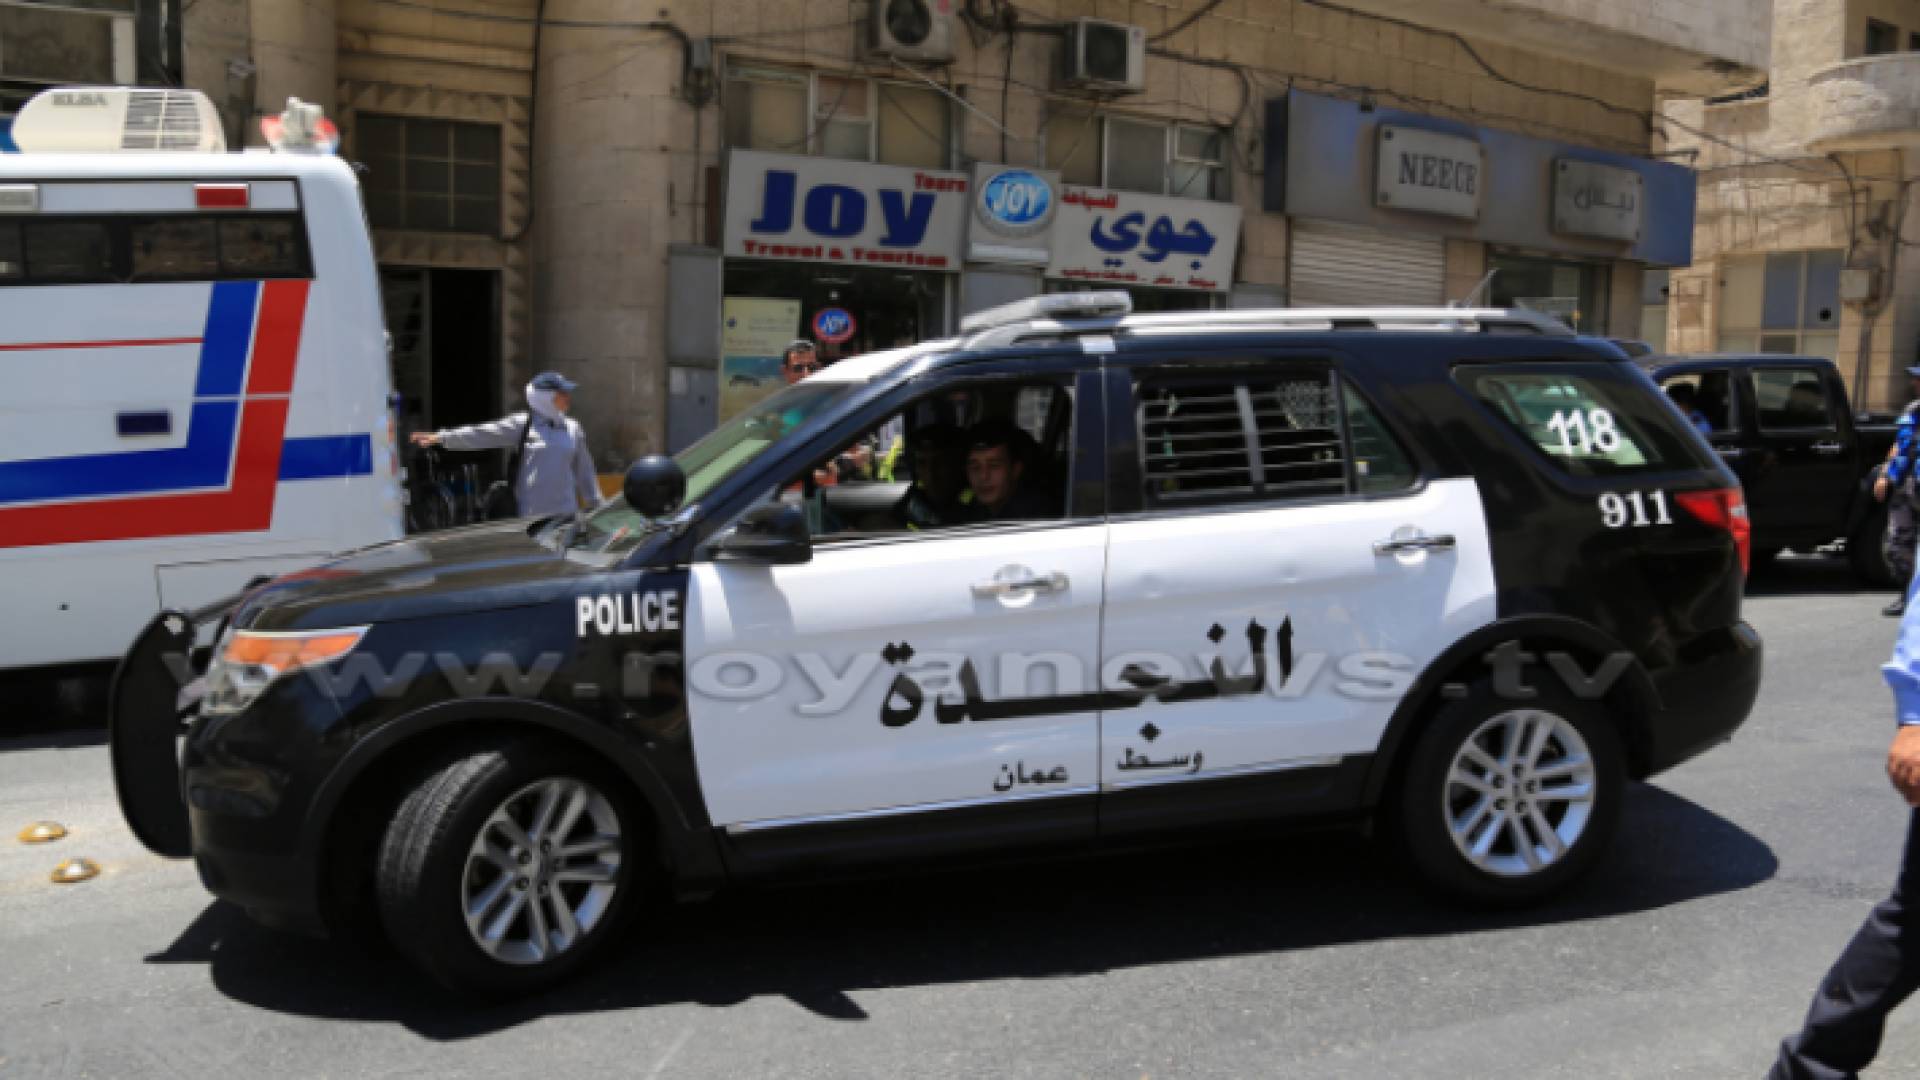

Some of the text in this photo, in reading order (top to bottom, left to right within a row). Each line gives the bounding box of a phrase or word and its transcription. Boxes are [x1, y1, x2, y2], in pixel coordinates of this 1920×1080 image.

[1398, 151, 1478, 197] NEECE
[992, 181, 1042, 216] JOY
[742, 239, 824, 258] Travel
[1089, 209, 1217, 271] جوي
[1547, 407, 1621, 457] 118
[1598, 488, 1673, 528] 911
[576, 590, 680, 639] POLICE
[880, 614, 1294, 742] النجدة
[992, 746, 1203, 792] وسط عمان
